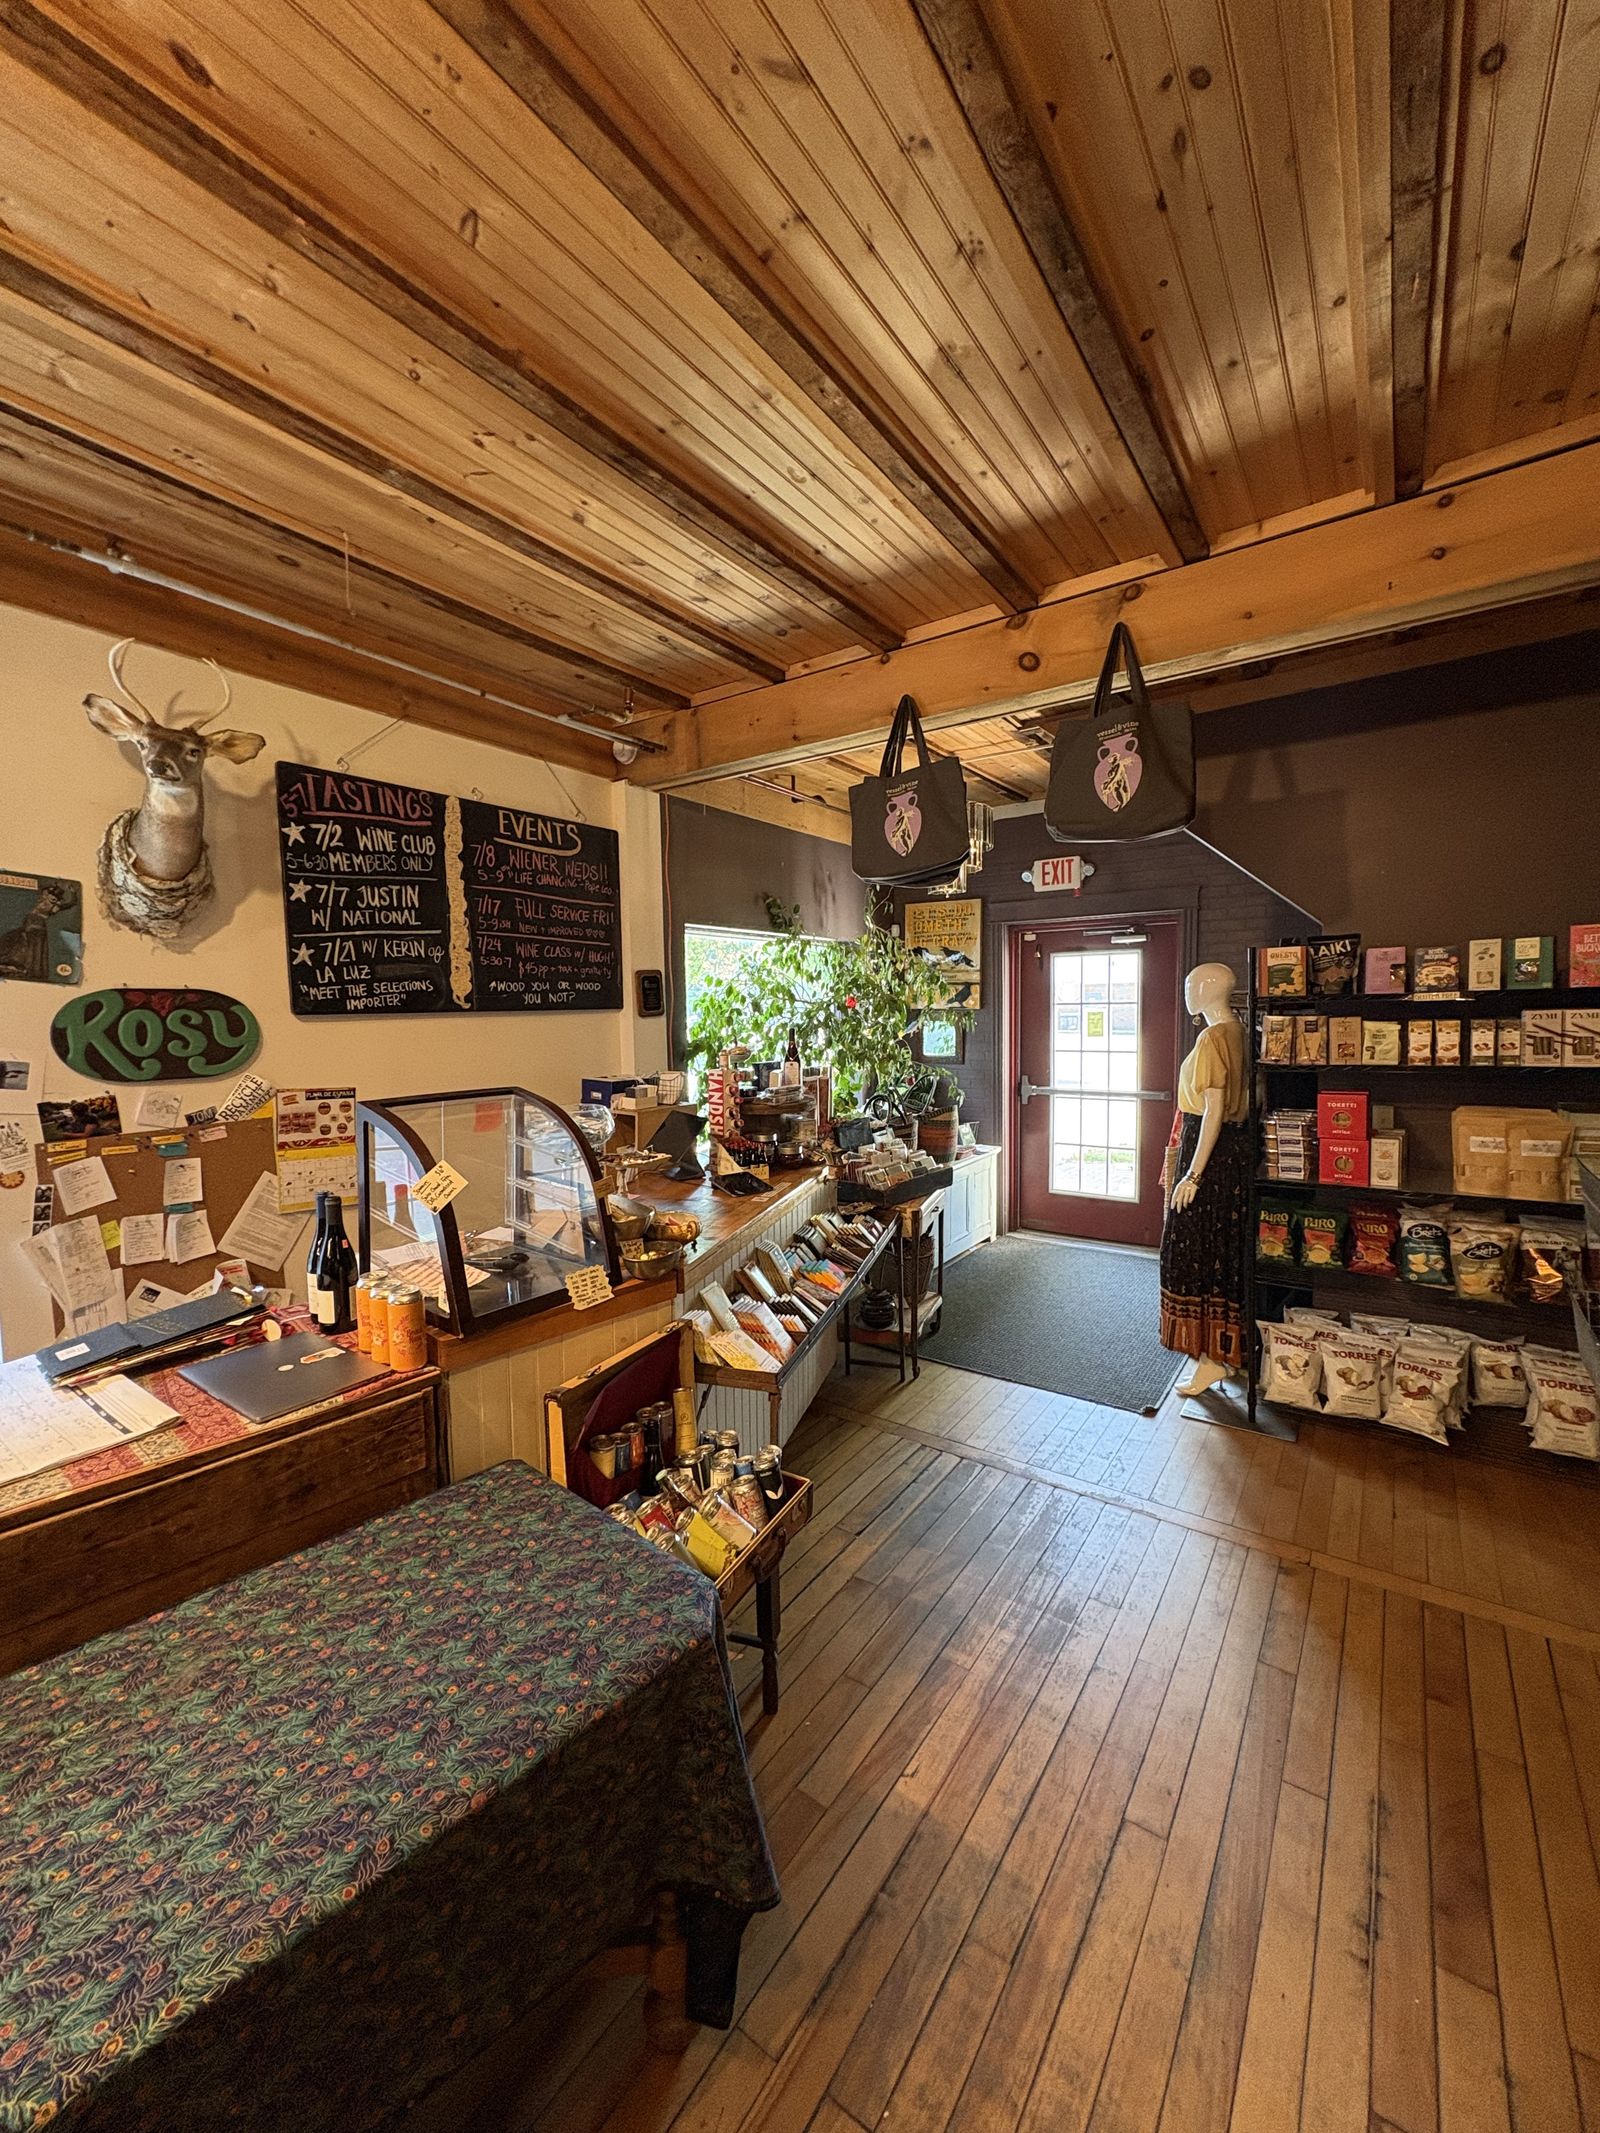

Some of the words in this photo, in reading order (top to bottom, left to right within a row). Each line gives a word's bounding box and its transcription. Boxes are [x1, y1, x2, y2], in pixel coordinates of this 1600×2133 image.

[300, 773, 433, 818] TASTINGS
[309, 820, 344, 851] 7/2
[401, 835, 436, 856] CLUB
[499, 811, 581, 846] EVENTS
[328, 852, 397, 873] MEMBERS
[401, 856, 433, 872] ONLY
[470, 840, 496, 868] 7/8
[508, 848, 560, 875] WIENER
[1041, 858, 1074, 886] EXIT
[315, 880, 350, 907] 7/7
[357, 885, 419, 908] JUSTIN
[343, 910, 421, 926] NATIONAL
[474, 894, 501, 916] 7/17
[515, 898, 545, 919] FULL
[550, 904, 590, 922] SERVICE
[320, 938, 356, 966] 7/21
[384, 939, 425, 958] KERIN
[477, 935, 502, 955] 7/24
[515, 942, 540, 959] WINE
[544, 945, 572, 958] CLASS
[316, 966, 335, 983] LA
[343, 965, 371, 980] LUZ
[498, 981, 525, 991] WOOD
[531, 981, 550, 991] YOU
[558, 981, 570, 990] OR
[575, 982, 601, 991] WOOD
[345, 984, 367, 997] THE
[523, 993, 541, 1005] YOU
[549, 992, 576, 1003] NOT?
[219, 1077, 264, 1121] RECYCLE
[231, 1086, 266, 1121] DAMMIT
[1330, 1350, 1378, 1361] TORRES
[1396, 1361, 1444, 1381] TORRES
[1537, 1377, 1597, 1395] TORRES
